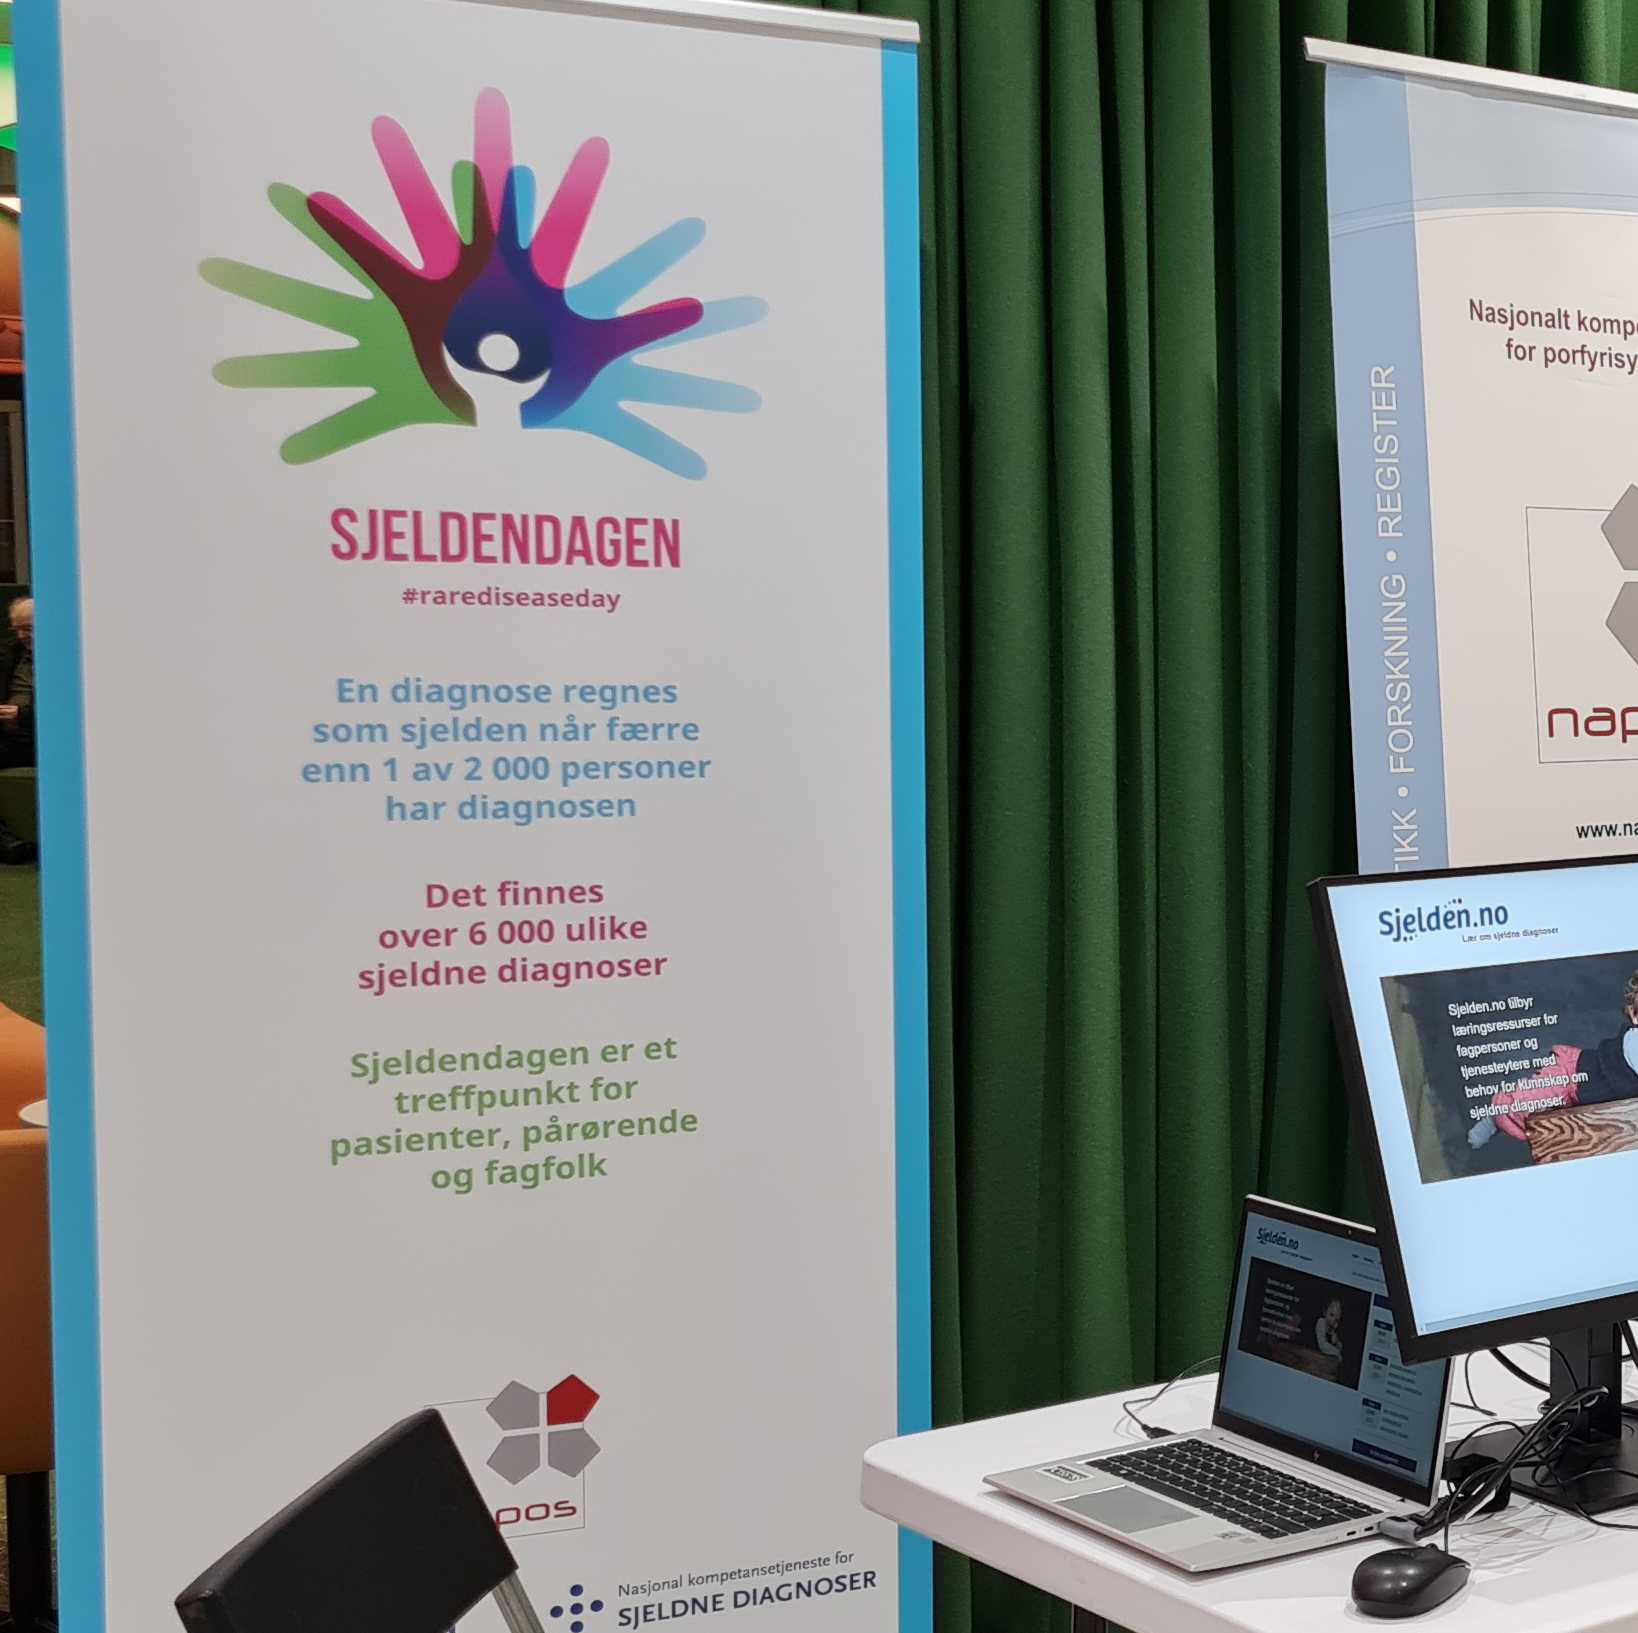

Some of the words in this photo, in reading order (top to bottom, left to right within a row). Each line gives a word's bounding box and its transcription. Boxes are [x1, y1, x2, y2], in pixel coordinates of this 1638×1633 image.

[1470, 299, 1570, 331] Nasjonalt
[1506, 338, 1536, 361] for
[1370, 366, 1404, 538] REGISTER
[331, 508, 680, 568] SJELDENDAGEN
[402, 586, 620, 613] #rarediseaseday
[1381, 575, 1415, 774] FORSKNING
[337, 678, 378, 703] En
[391, 677, 551, 710] diagnose
[564, 685, 677, 710] regnes
[313, 724, 388, 743] som
[401, 717, 526, 750] sjelden
[540, 714, 596, 741] når
[606, 716, 699, 741] færre
[302, 763, 370, 783] enn
[383, 758, 397, 782] 1
[413, 763, 453, 781] av
[464, 757, 482, 781] 2
[493, 756, 550, 780] 000
[562, 760, 711, 787] personer
[386, 796, 447, 821] har
[458, 794, 636, 826] diagnosen
[427, 884, 487, 908] Det
[497, 881, 603, 906] finnes
[379, 928, 458, 949] over
[469, 922, 487, 945] 6
[498, 919, 554, 944] 000
[567, 916, 647, 942] ulike
[1379, 904, 1508, 942] Sjelden.no
[359, 961, 486, 996] sjeldne
[498, 957, 667, 988] diagnoser
[1448, 1000, 1506, 1018] Sjelden.no
[1508, 996, 1534, 1010] tilbyr
[1452, 1015, 1541, 1036] læringsressurser
[1544, 1013, 1558, 1026] for
[351, 1045, 589, 1084] Sjeldendagen
[601, 1044, 634, 1063] er
[645, 1038, 677, 1060] et
[1456, 1039, 1522, 1058] fagpersoner
[1524, 1038, 1538, 1050] og
[1460, 1058, 1530, 1080] tjenesteytere
[1532, 1054, 1556, 1068] med
[395, 1080, 580, 1118] treffpunkt
[590, 1077, 638, 1101] for
[1465, 1083, 1498, 1098] behov
[1501, 1080, 1516, 1093] for
[1518, 1074, 1569, 1090] kunnskap
[1572, 1072, 1588, 1083] om
[1470, 1103, 1508, 1121] sjeldne
[1512, 1096, 1566, 1113] diagnoser.
[331, 1127, 510, 1165] pasienter,
[523, 1109, 697, 1151] pårørende
[432, 1168, 472, 1194] og
[485, 1153, 607, 1189] fagfolk
[619, 1575, 682, 1596] Nasjonal
[688, 1554, 831, 1588] kompetansetjeneste
[835, 1551, 854, 1564] for
[619, 1593, 724, 1630] SJELDNE
[732, 1571, 876, 1608] DIAGNOSER
